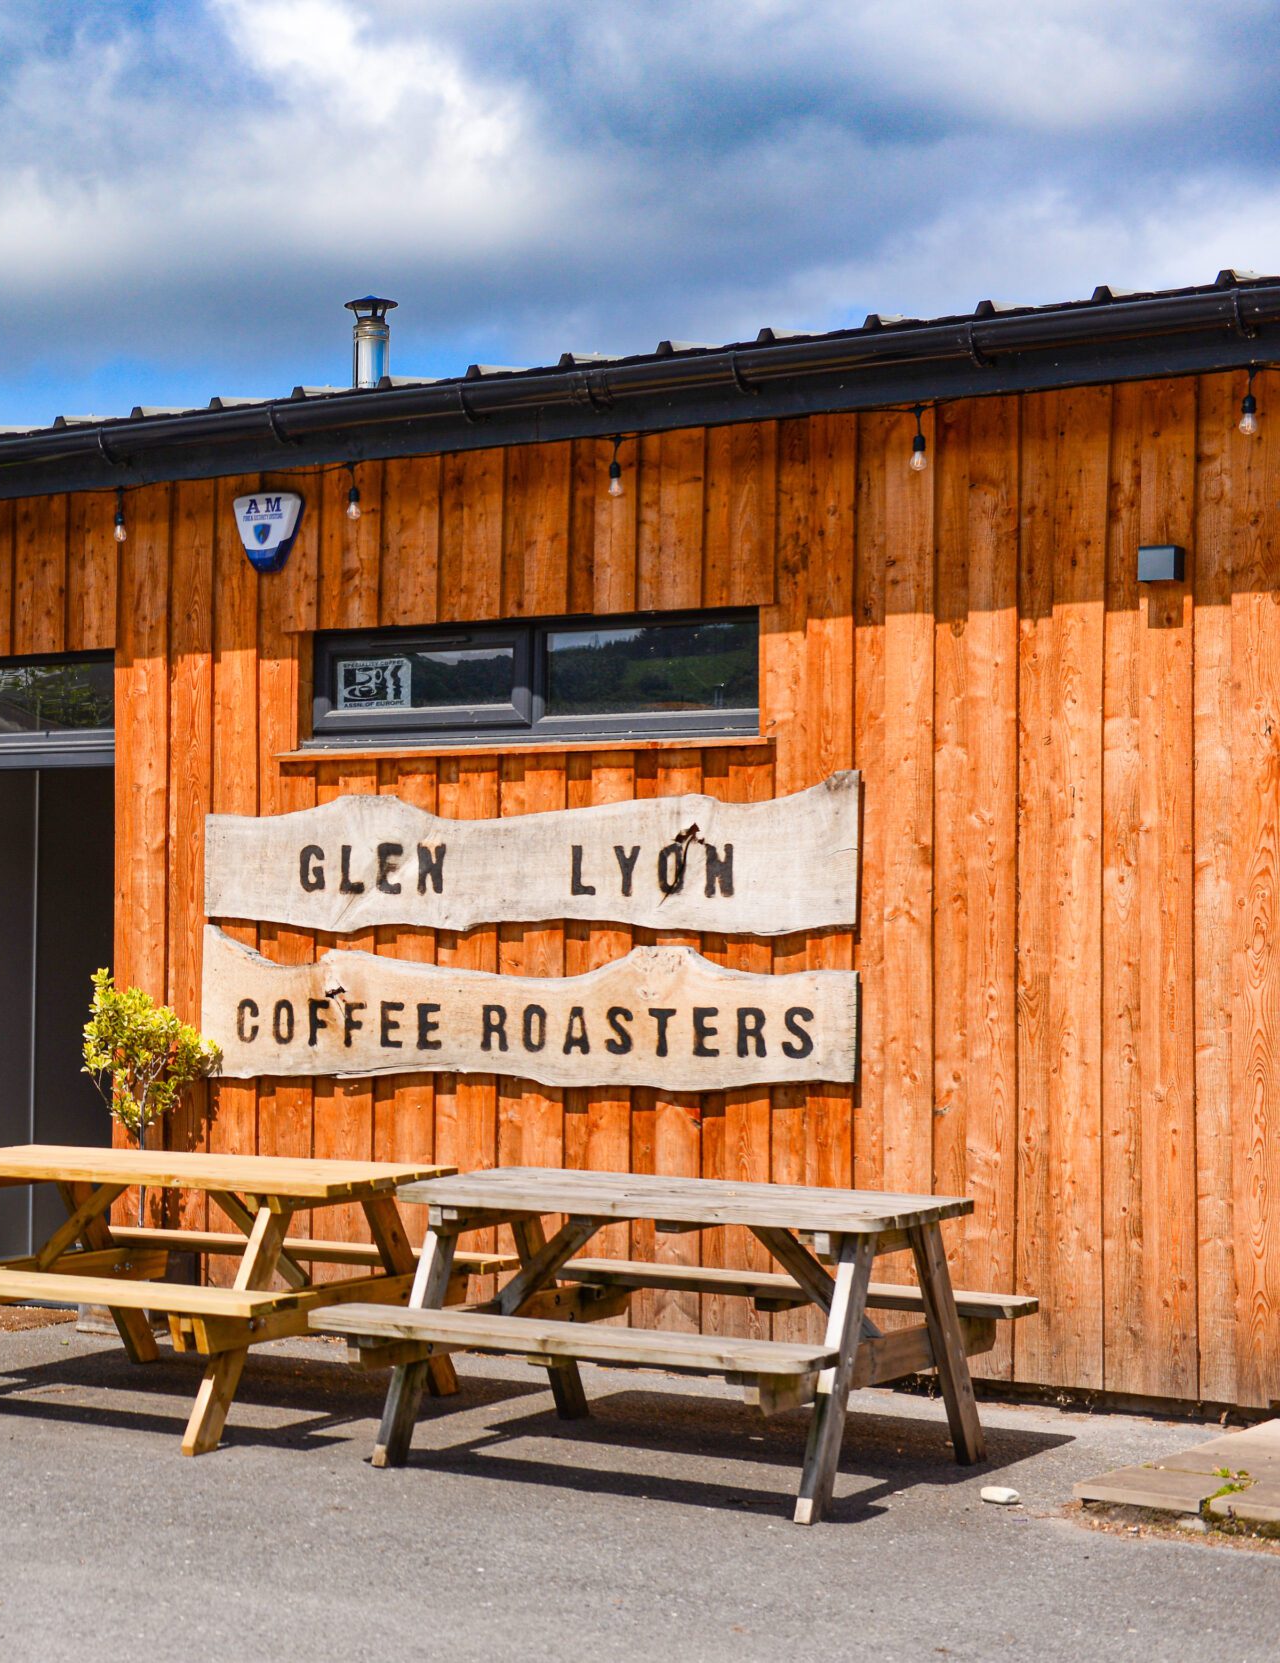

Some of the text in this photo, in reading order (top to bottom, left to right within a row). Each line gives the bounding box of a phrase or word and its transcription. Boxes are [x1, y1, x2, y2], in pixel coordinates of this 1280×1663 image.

[299, 842, 735, 899] GLEN LYON
[236, 999, 815, 1059] COFFEE ROASTERS
